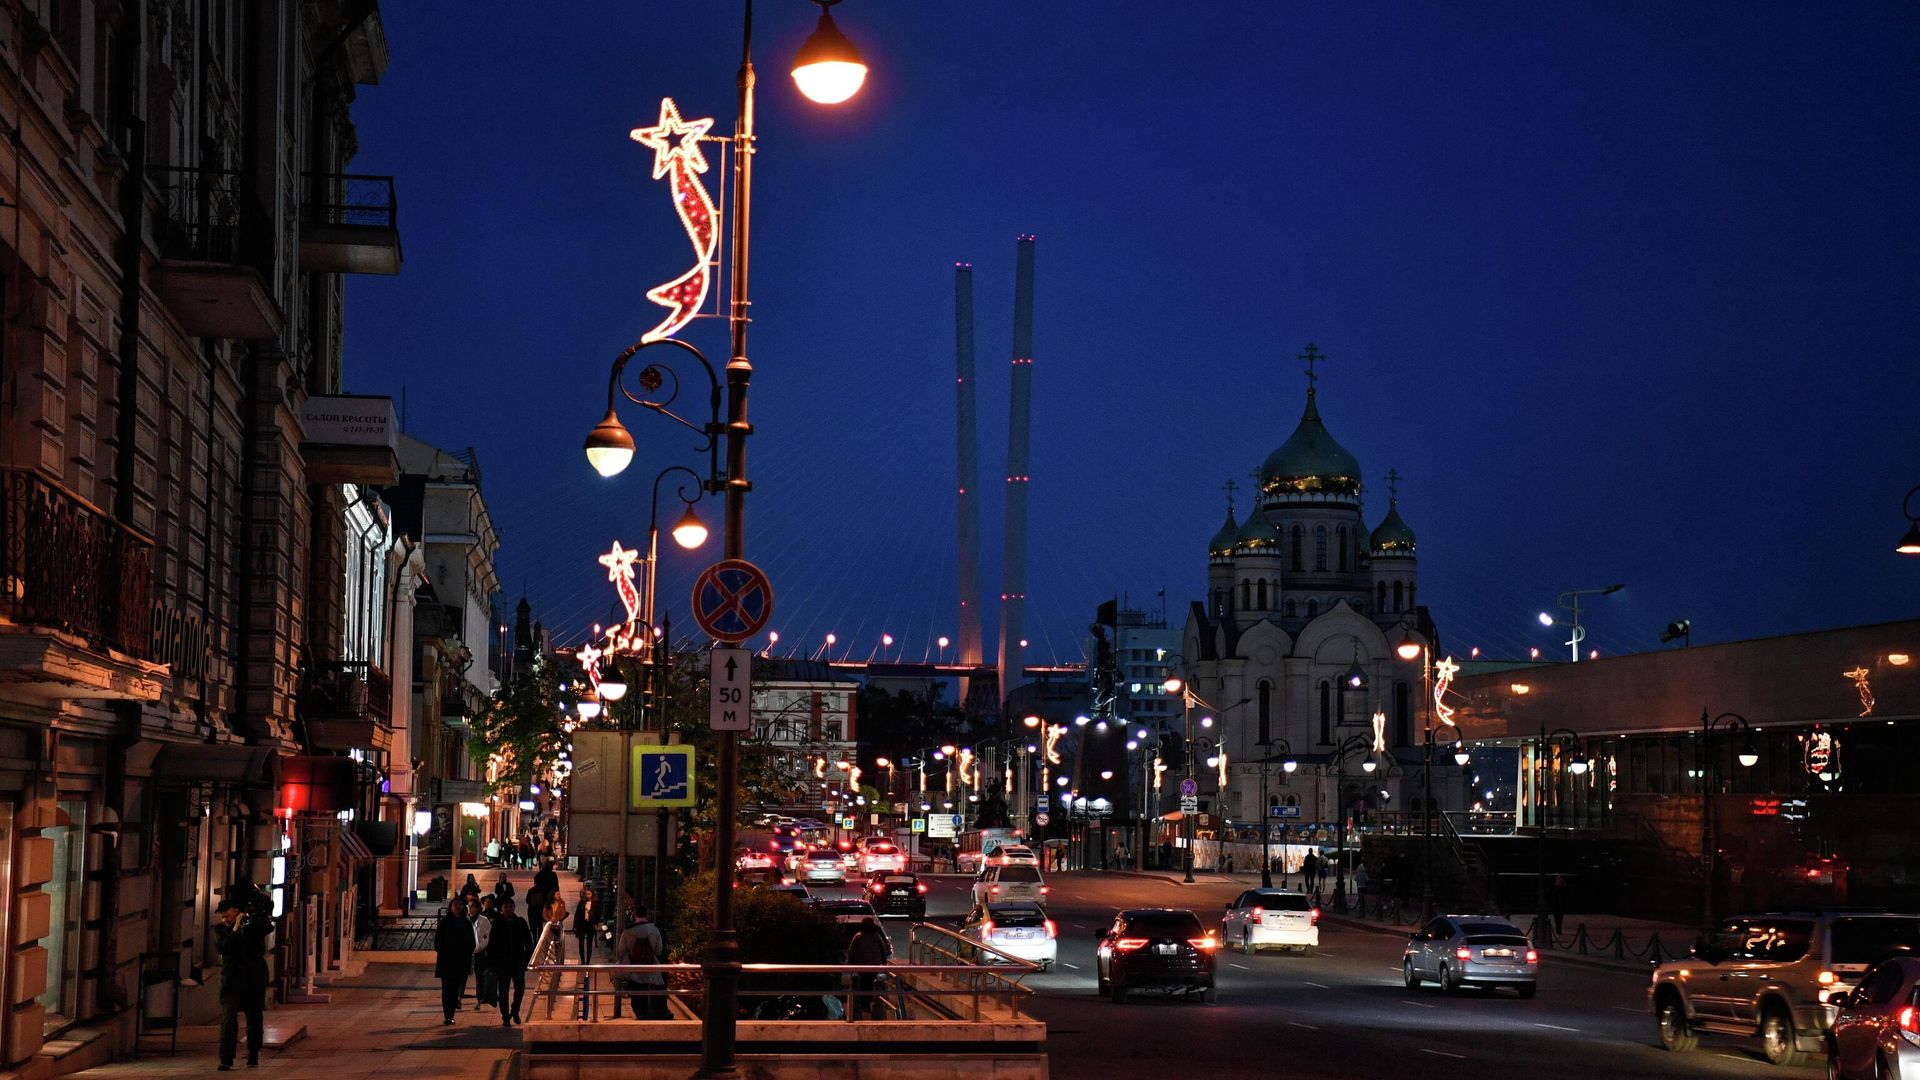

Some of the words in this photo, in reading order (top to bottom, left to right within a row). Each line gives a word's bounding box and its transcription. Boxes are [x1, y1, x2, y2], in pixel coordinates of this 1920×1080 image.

[306, 413, 340, 422] САЛОН
[342, 415, 387, 424] КРАСОТЫ
[720, 687, 741, 703] 50
